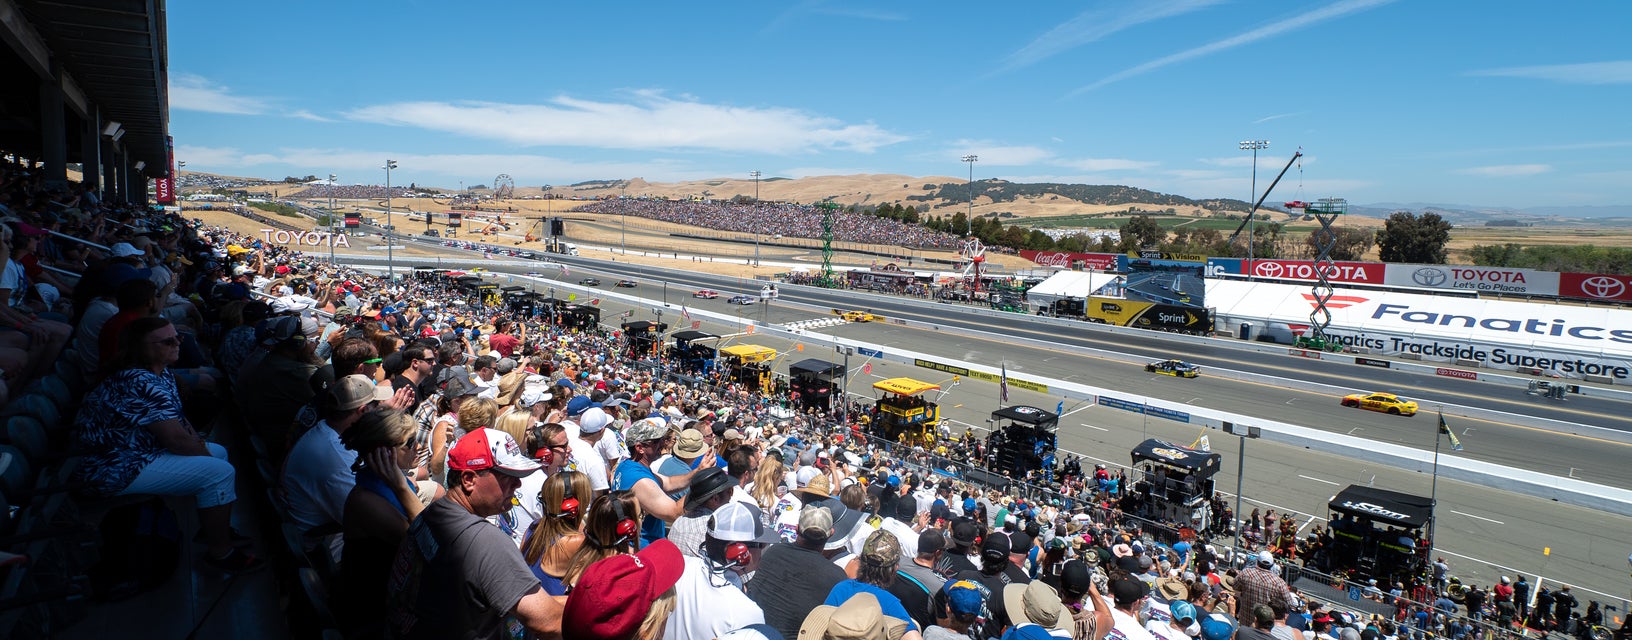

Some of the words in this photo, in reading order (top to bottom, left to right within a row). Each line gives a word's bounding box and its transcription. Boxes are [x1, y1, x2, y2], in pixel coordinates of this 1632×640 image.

[260, 228, 351, 248] TOYOTA
[1141, 251, 1161, 259] Sprint
[1286, 264, 1368, 280] TOYOTA
[1451, 268, 1526, 284] TOYOTA
[1453, 281, 1475, 289] Let's
[1478, 282, 1492, 291] Go
[1492, 284, 1527, 293] Places
[1158, 312, 1186, 324] Sprint
[1371, 303, 1632, 343] Fanatics
[1390, 337, 1487, 362] Trackside
[1491, 348, 1629, 379] Superstore
[1448, 370, 1477, 379] TOYOTA
